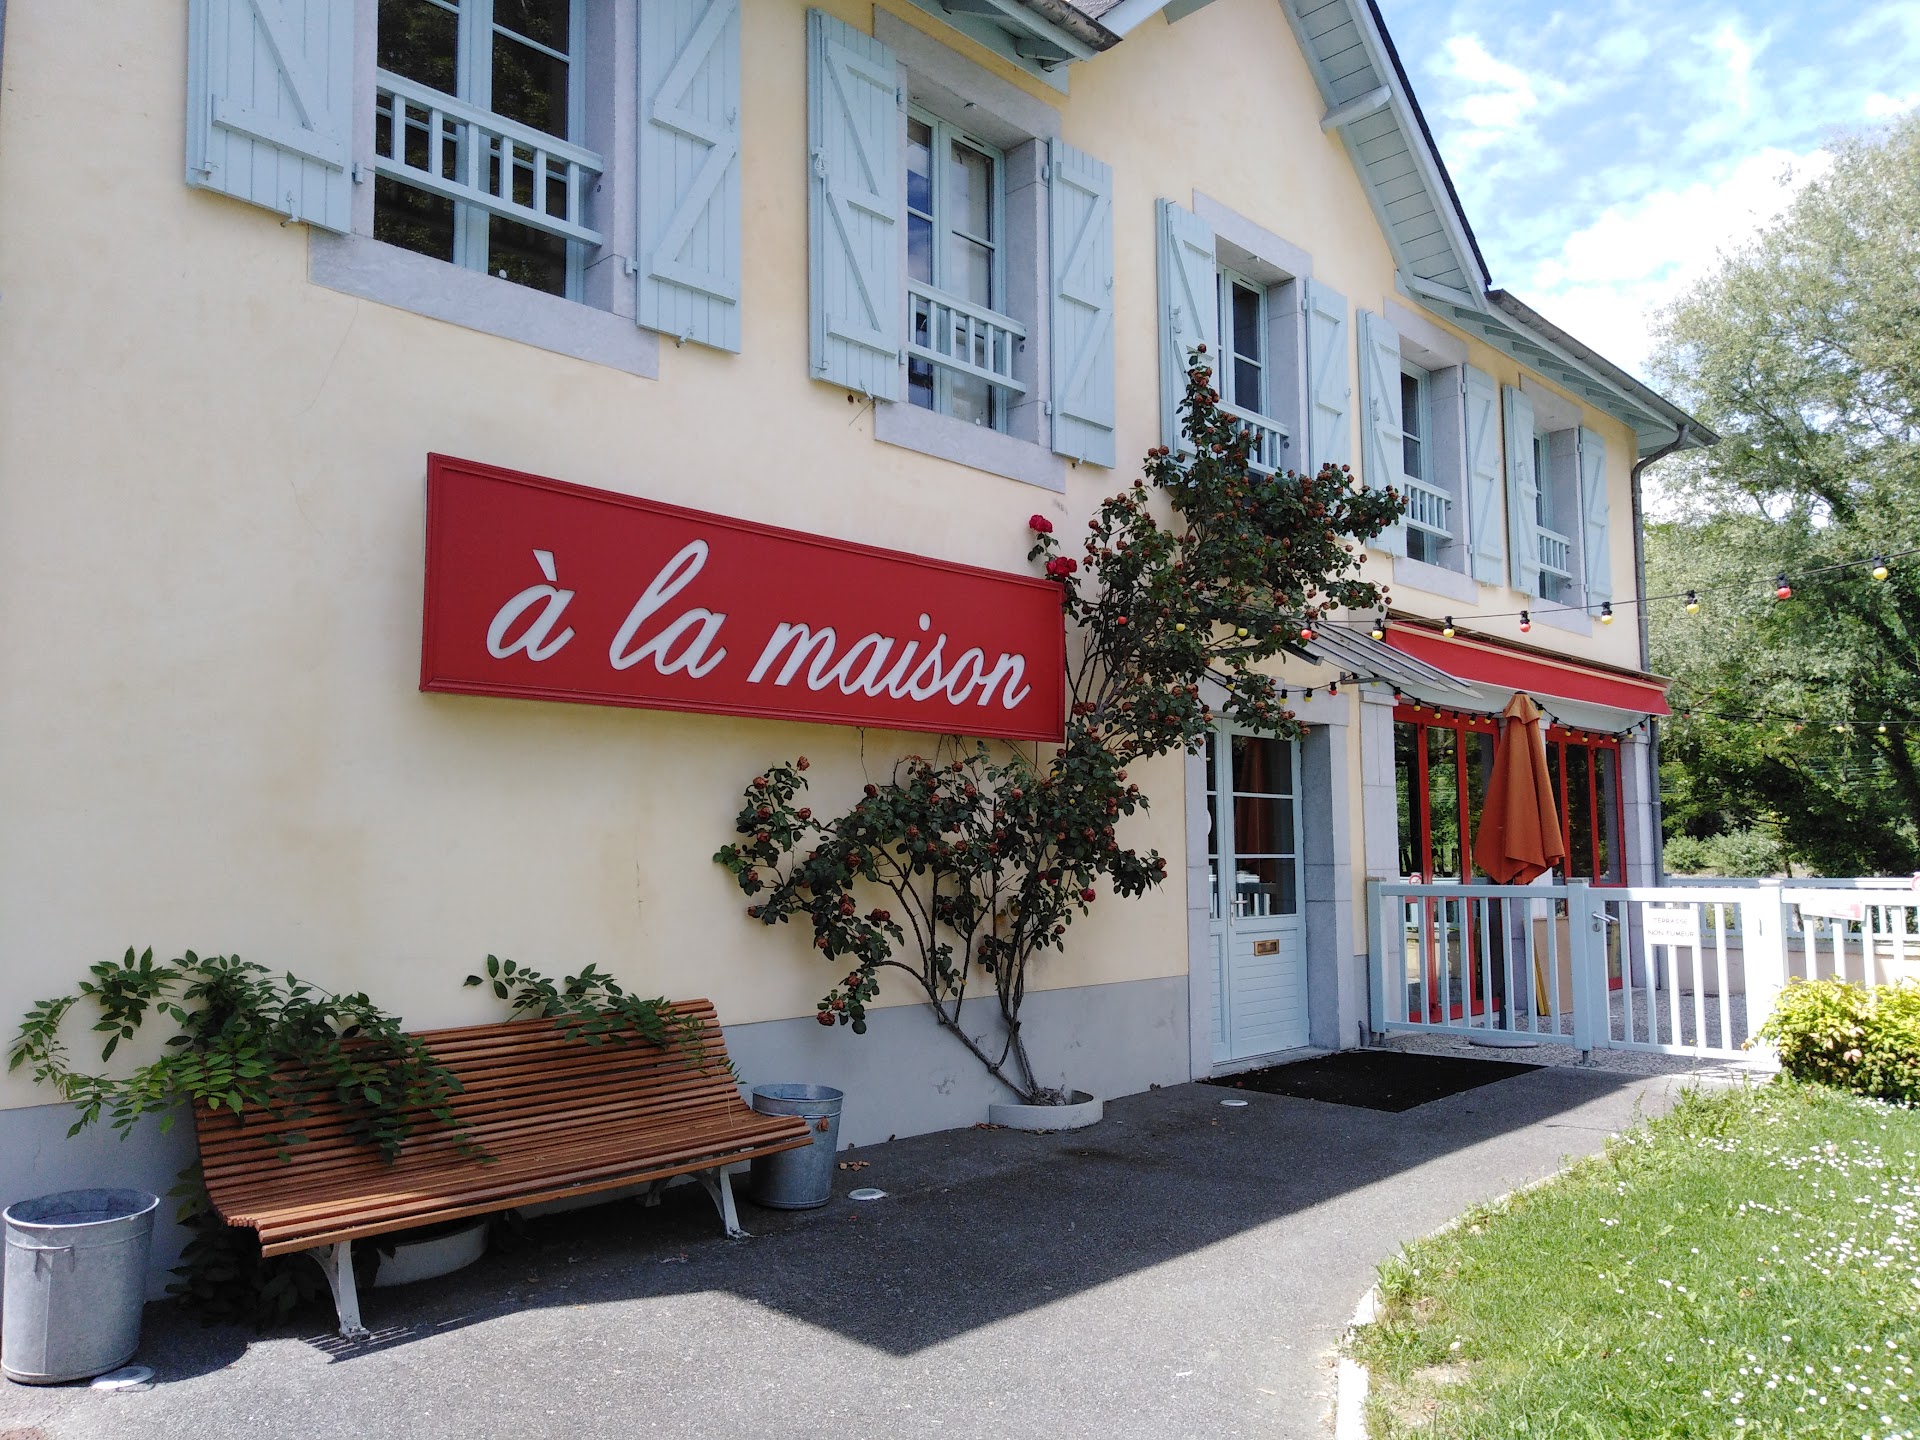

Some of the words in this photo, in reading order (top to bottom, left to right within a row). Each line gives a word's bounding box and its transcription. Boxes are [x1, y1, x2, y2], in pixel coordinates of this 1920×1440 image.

[486, 549, 576, 662] à
[609, 539, 728, 679] la
[747, 613, 1032, 710] maison
